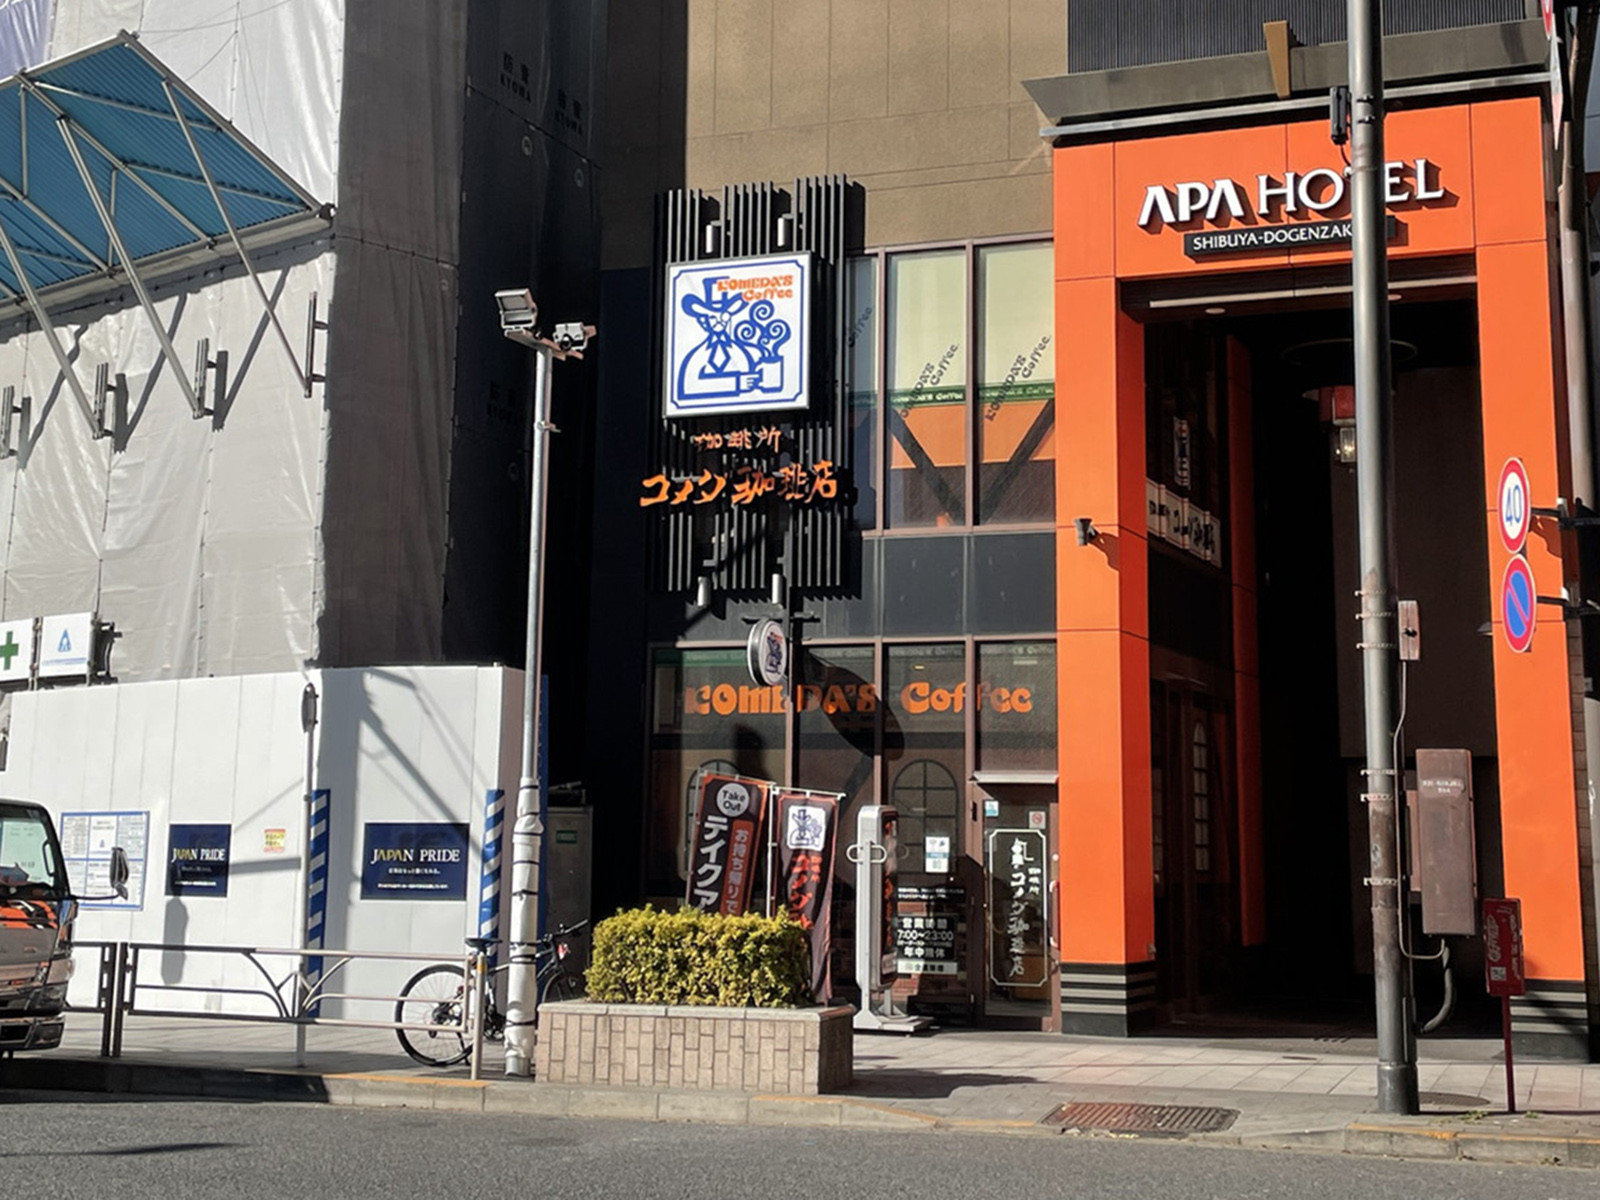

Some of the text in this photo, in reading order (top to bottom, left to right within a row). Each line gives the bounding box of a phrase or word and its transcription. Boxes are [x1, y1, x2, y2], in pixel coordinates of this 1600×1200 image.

[1138, 158, 1445, 226] APA HOEL
[1192, 226, 1353, 250] SHIBUYA-DOGENZAK
[717, 275, 793, 292] KOMEDA'S
[742, 289, 793, 301] Coffee
[930, 343, 958, 386] Coffee
[1021, 335, 1050, 379] Coffee
[1505, 485, 1522, 524] 40
[722, 789, 746, 802] Take
[723, 800, 741, 812] Out
[171, 847, 226, 863] JAPAN PRIDE
[370, 849, 460, 865] JAPAN PRIDE
